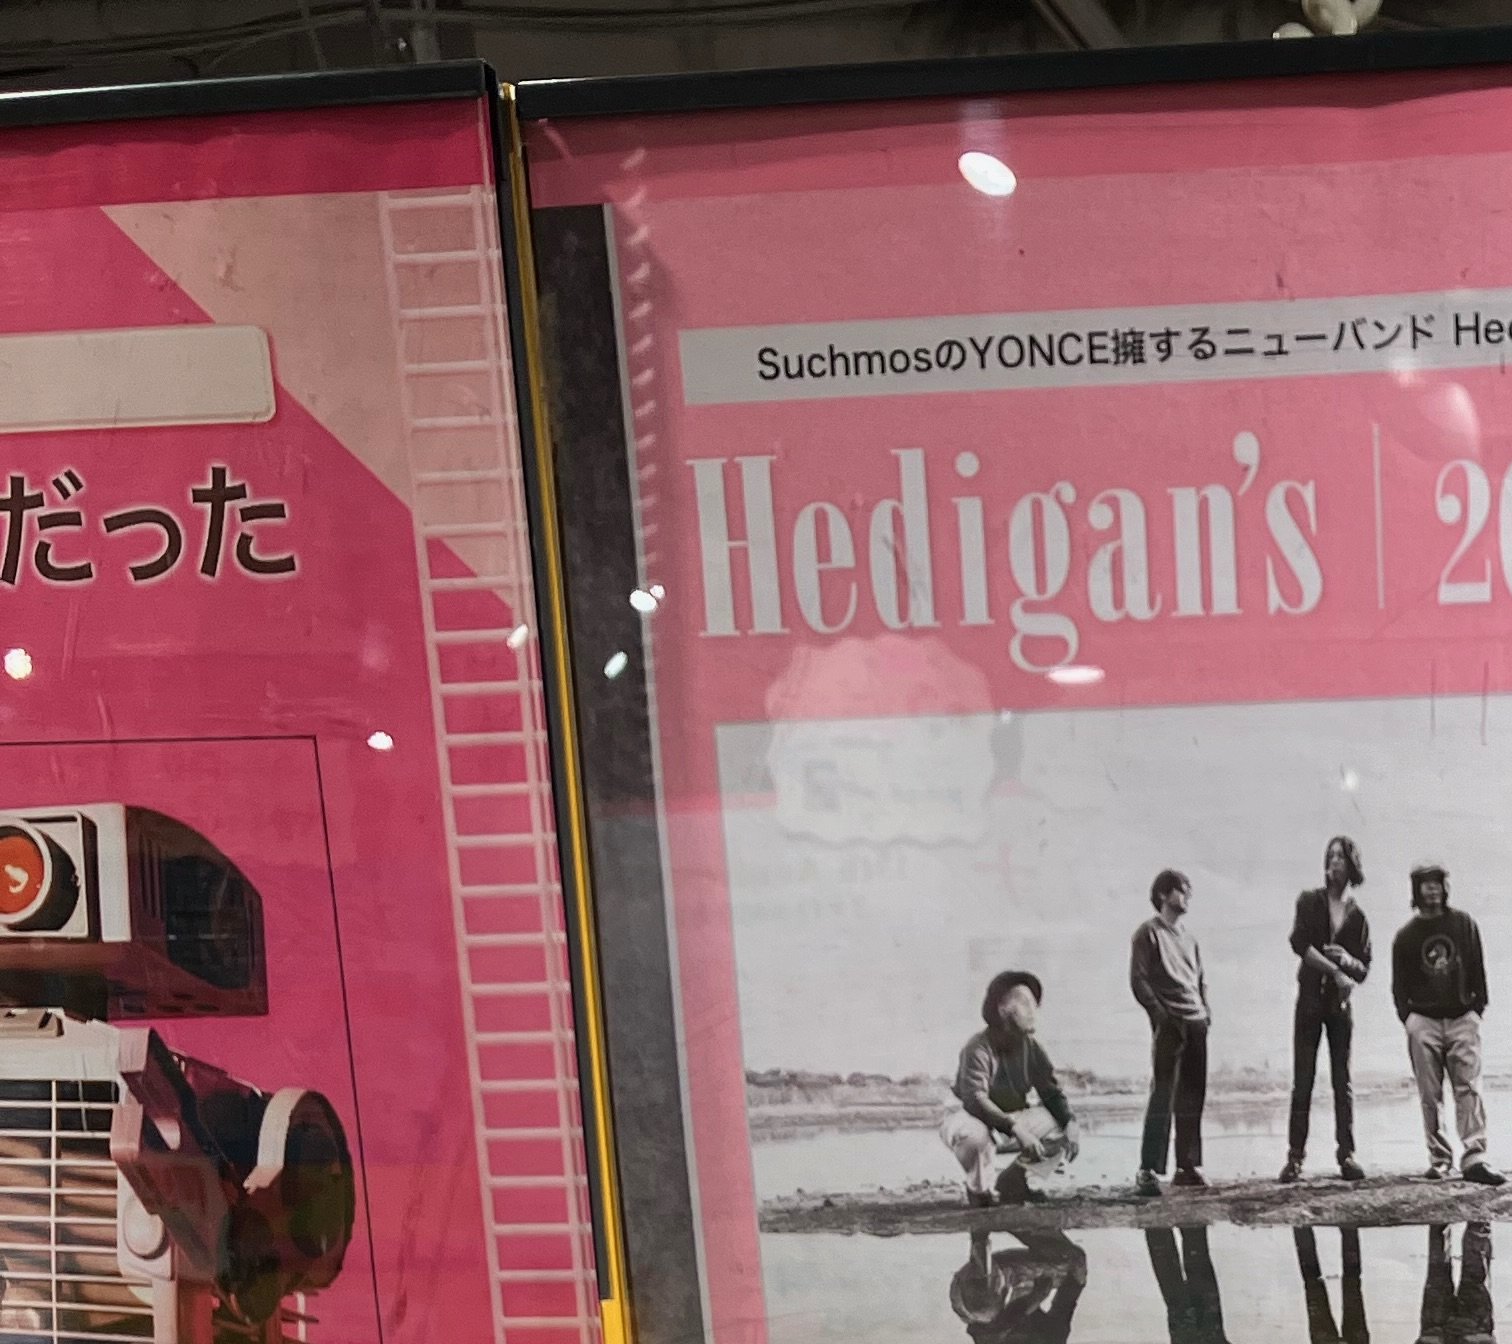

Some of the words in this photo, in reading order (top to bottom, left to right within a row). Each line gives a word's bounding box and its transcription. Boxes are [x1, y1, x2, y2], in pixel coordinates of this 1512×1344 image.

[756, 314, 1435, 383] SuchmosのYONCE擁するニューバンド
[0, 466, 296, 584] だった
[686, 431, 1324, 673] Hedigan's
